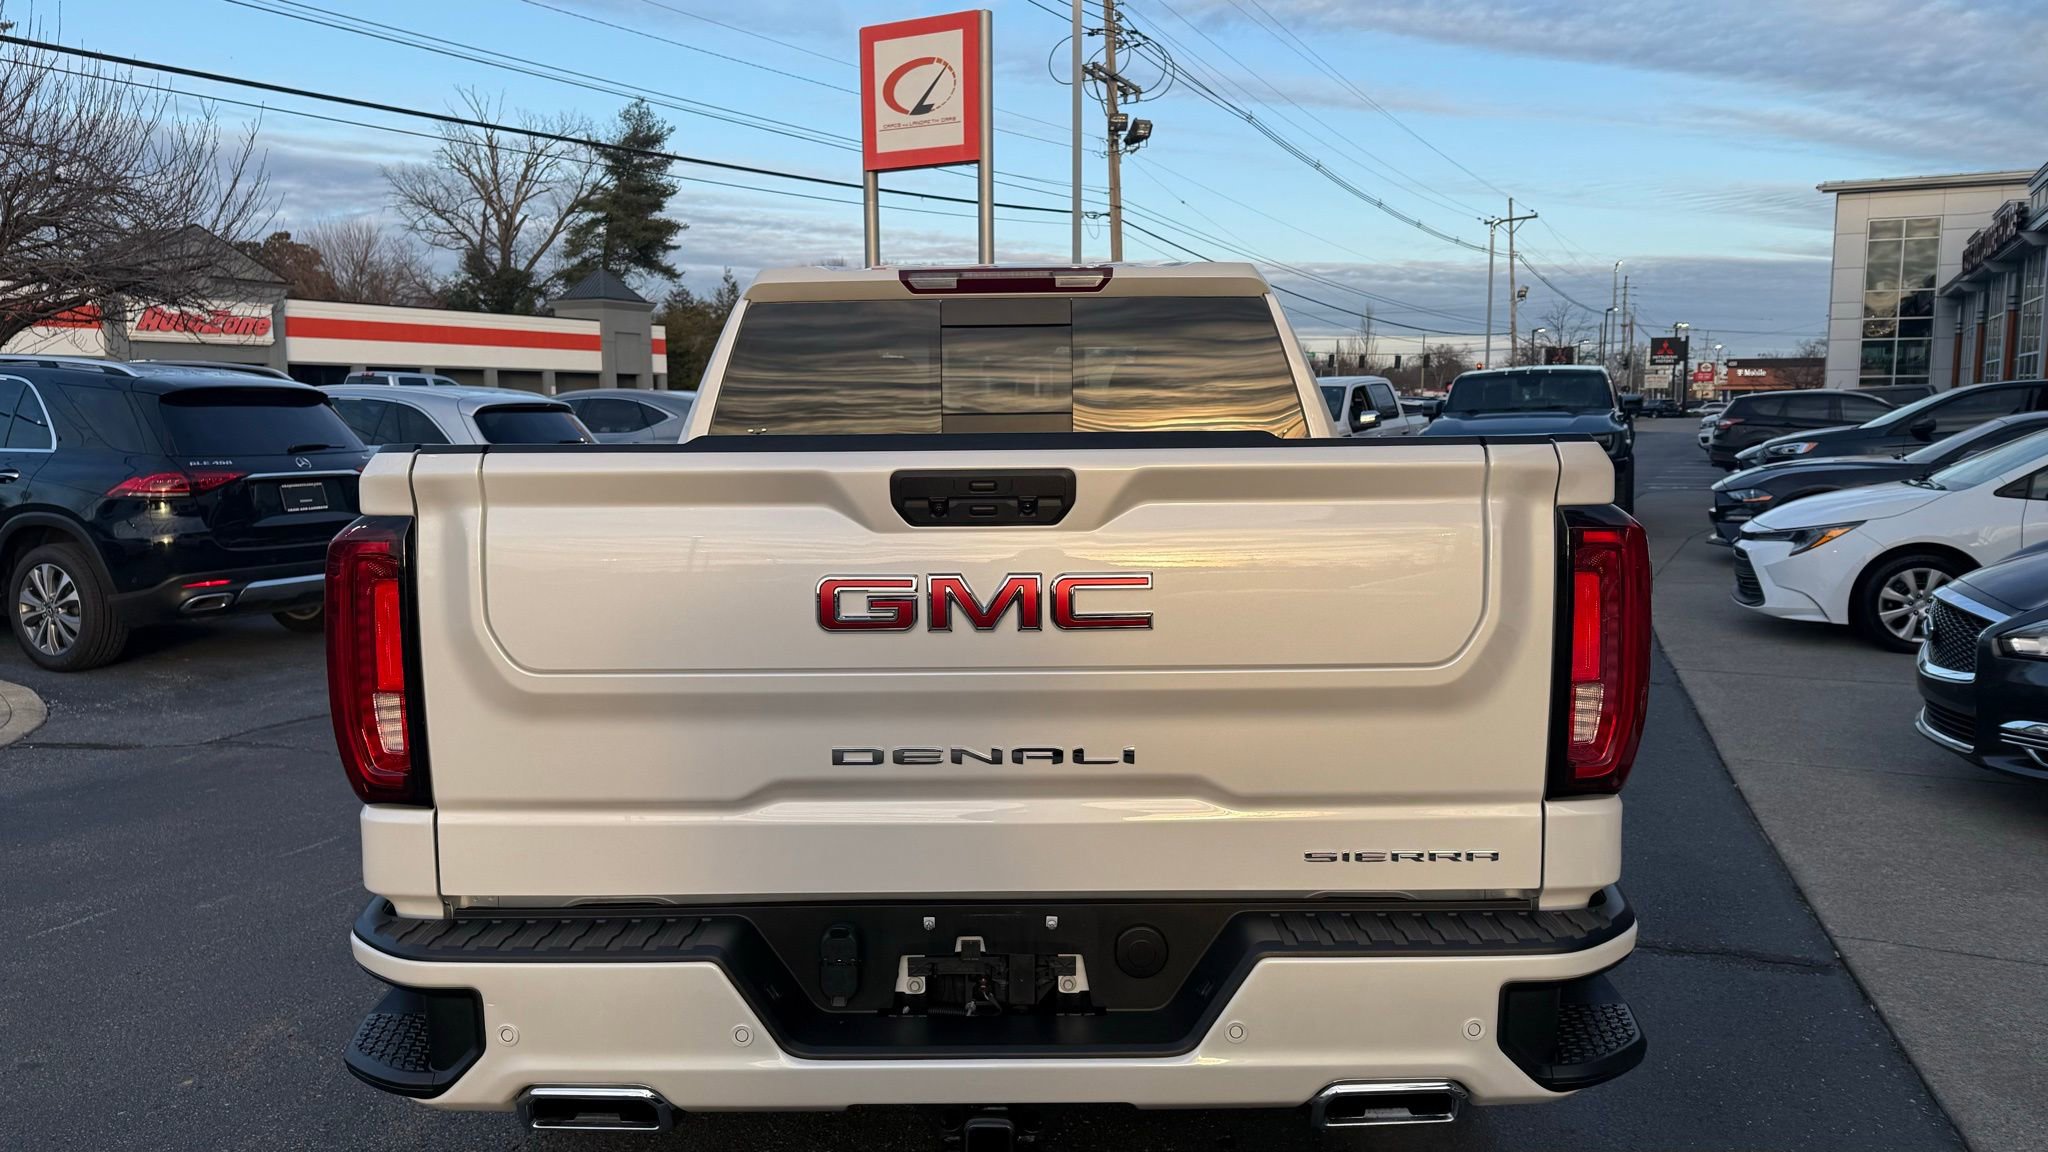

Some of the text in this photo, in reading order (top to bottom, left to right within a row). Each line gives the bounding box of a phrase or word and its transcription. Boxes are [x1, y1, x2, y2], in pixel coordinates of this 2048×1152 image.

[815, 572, 1154, 632] GMC
[831, 746, 1136, 766] DENALI
[1304, 850, 1499, 862] SIERRA
